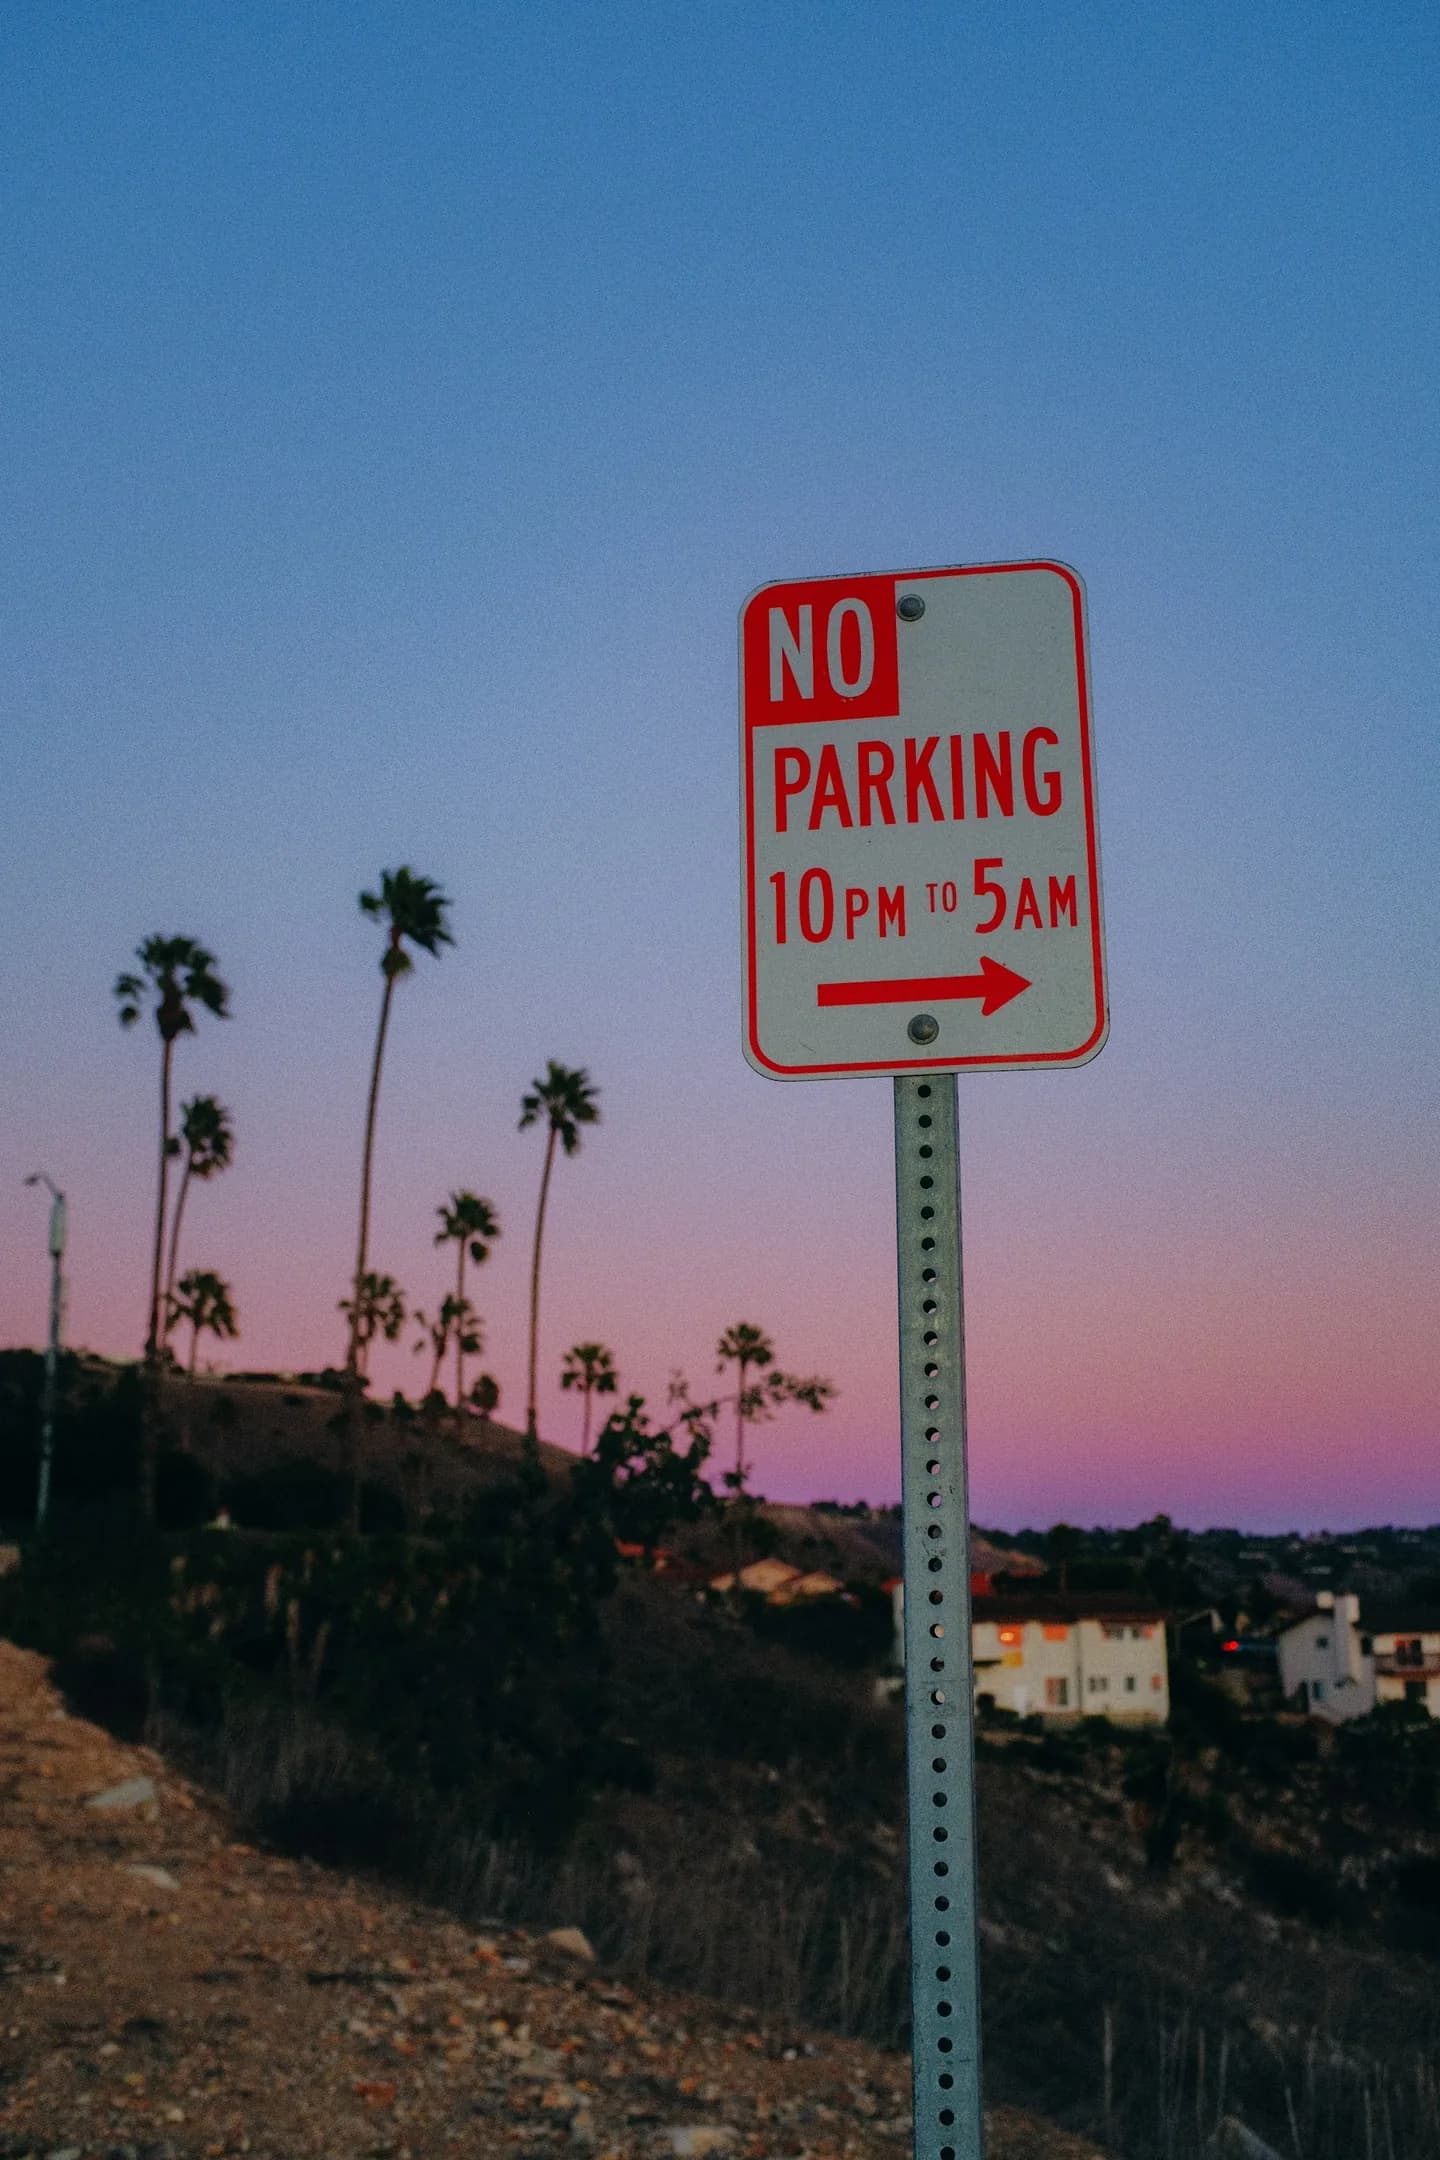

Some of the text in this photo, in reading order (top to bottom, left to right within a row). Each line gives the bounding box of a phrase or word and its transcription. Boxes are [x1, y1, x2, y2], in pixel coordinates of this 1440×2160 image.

[768, 597, 875, 703] NO
[773, 726, 1063, 833] PARKING
[768, 857, 1079, 944] 10PM TO 5AM
